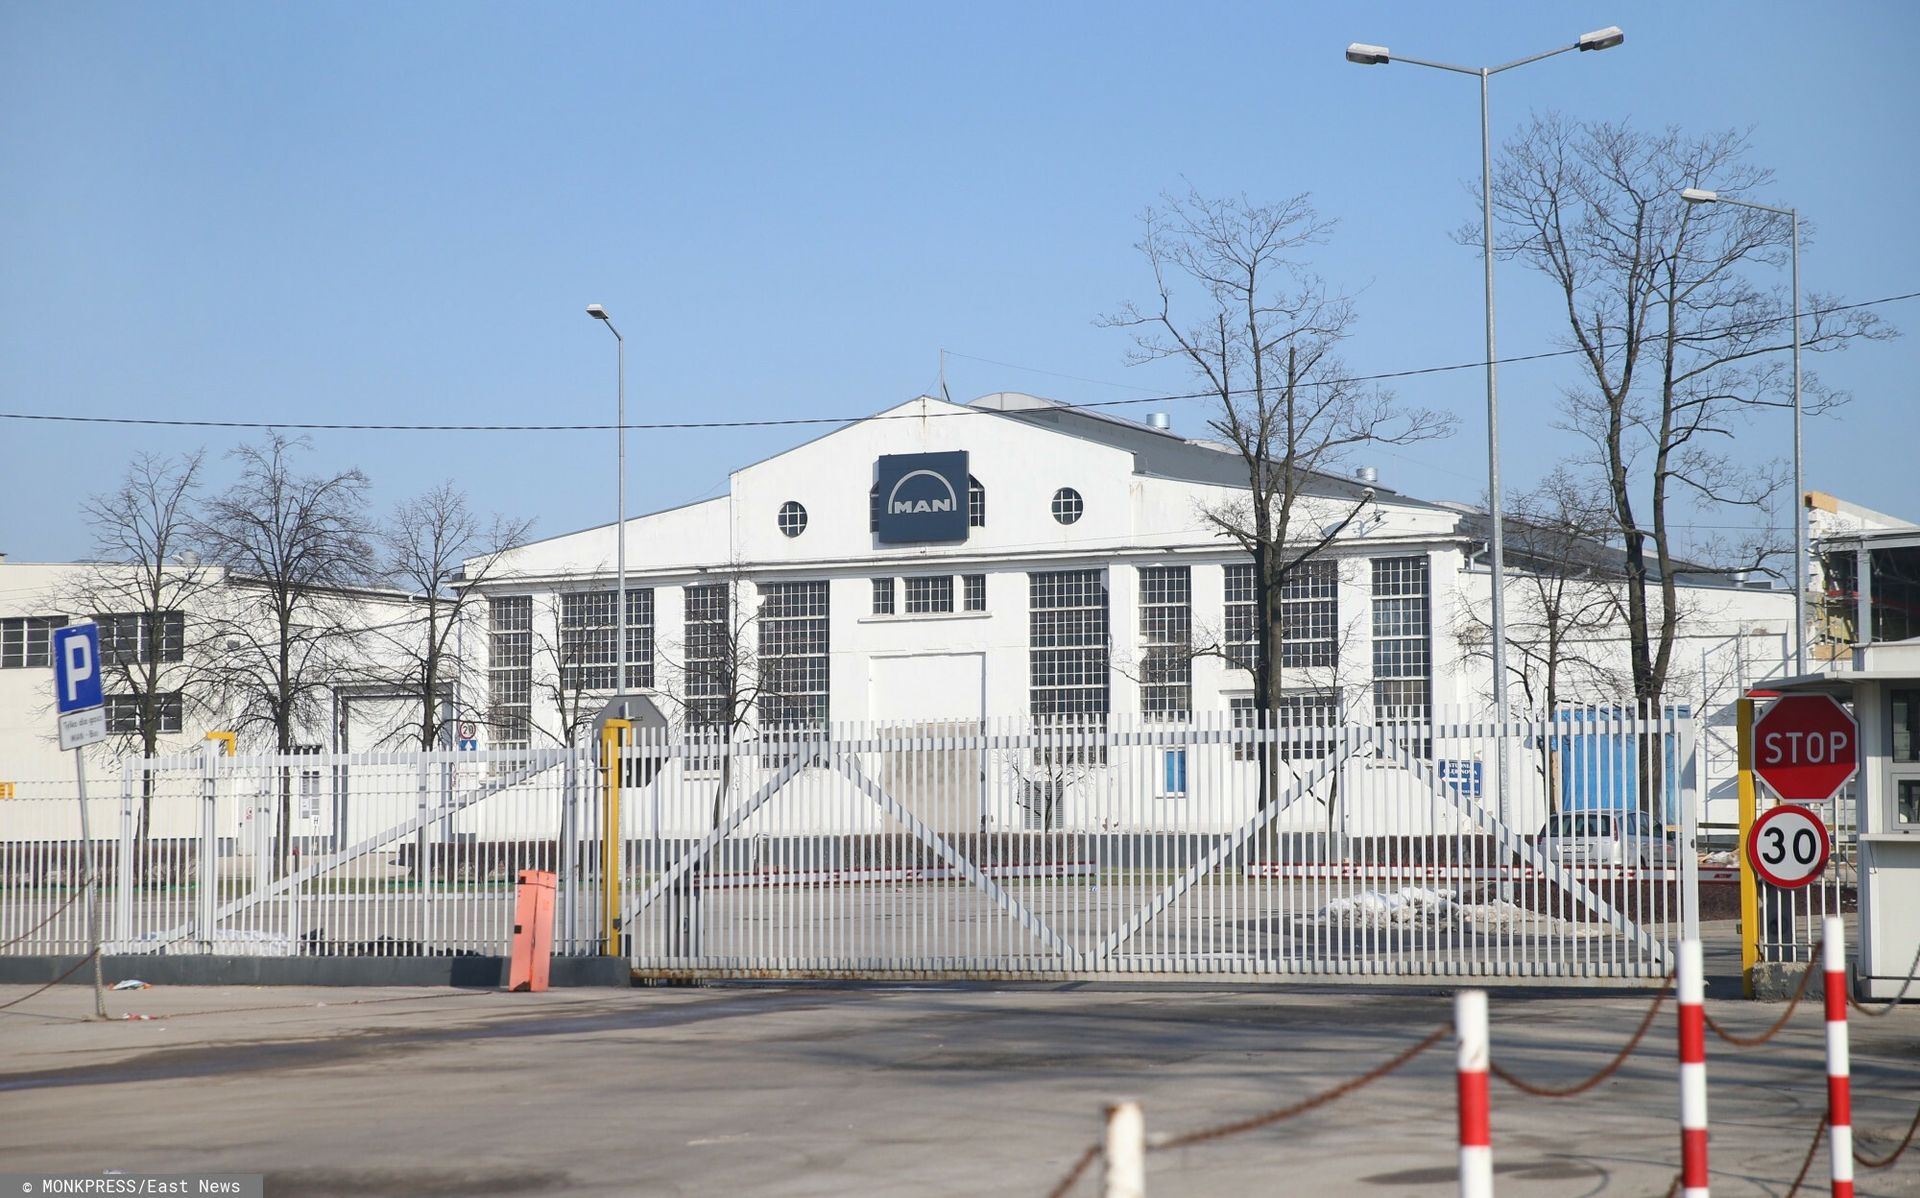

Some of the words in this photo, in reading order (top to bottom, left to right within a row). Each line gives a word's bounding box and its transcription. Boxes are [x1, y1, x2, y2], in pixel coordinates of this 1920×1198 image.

[894, 499, 951, 514] MAN
[64, 634, 93, 702] P
[462, 725, 474, 735] 20
[1765, 731, 1848, 764] STOP
[1762, 826, 1817, 865] 30
